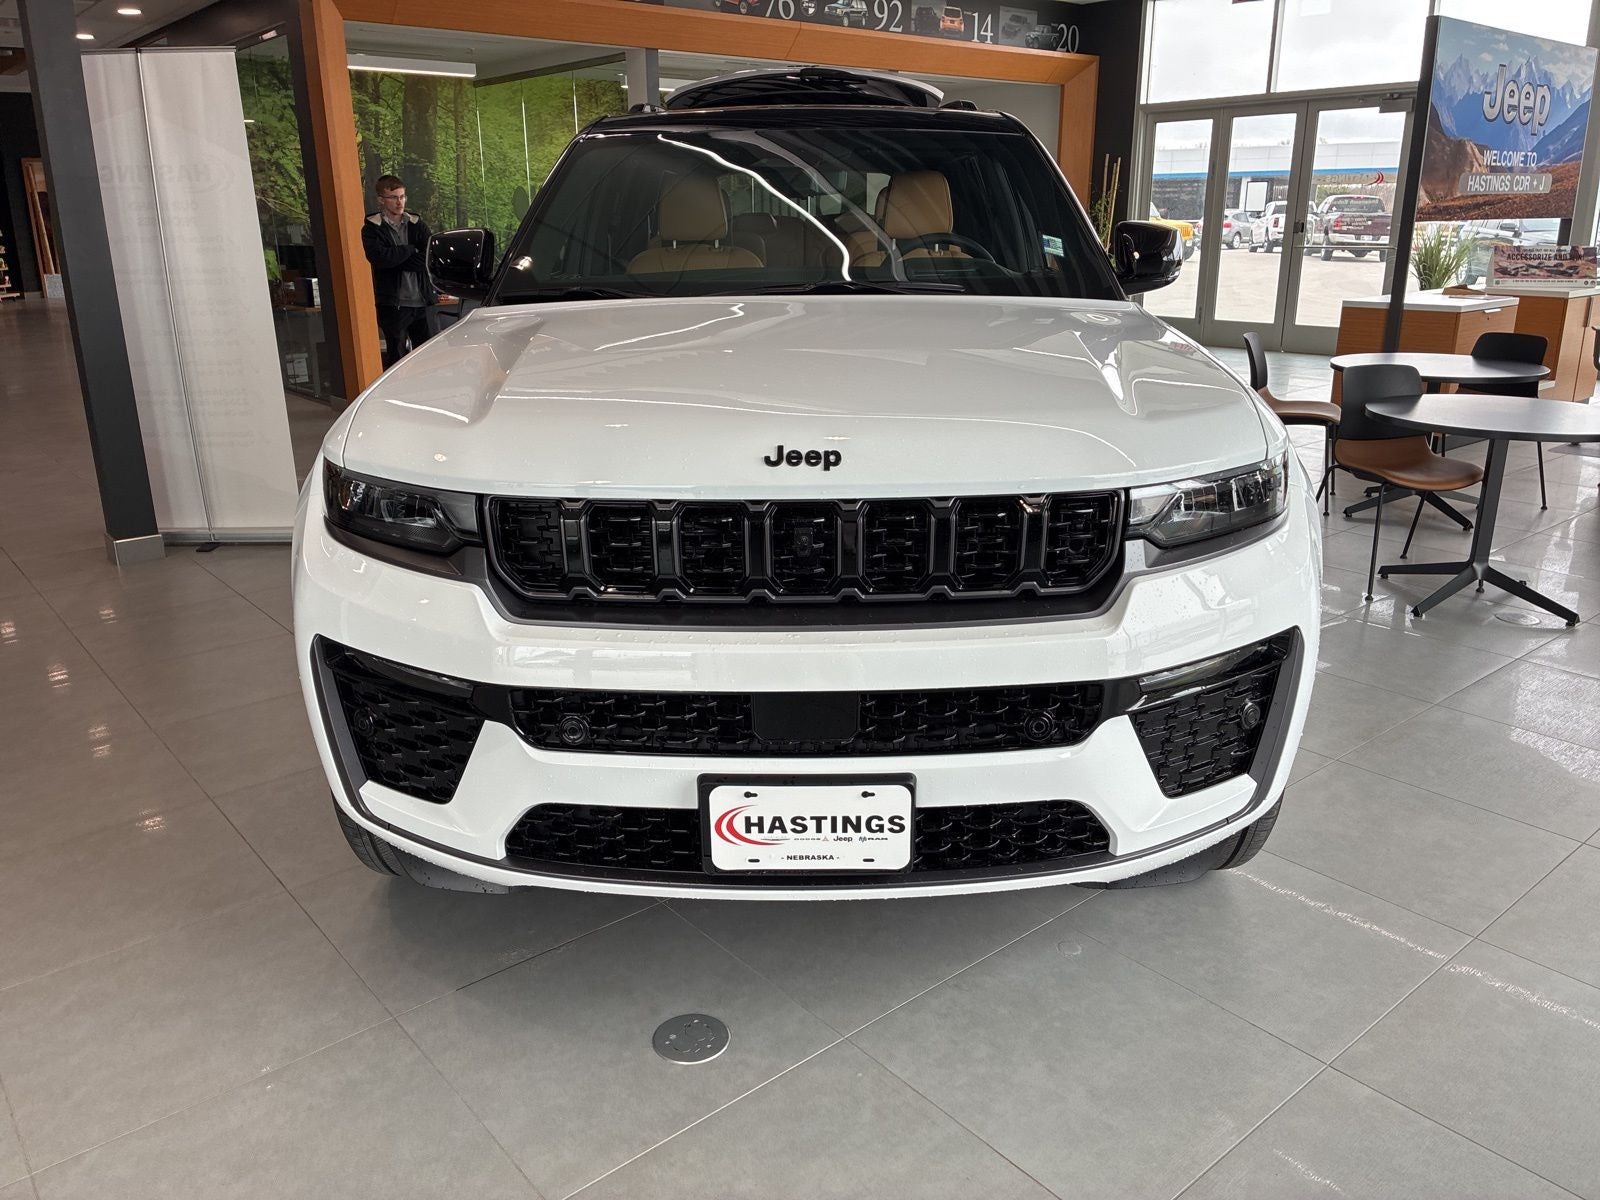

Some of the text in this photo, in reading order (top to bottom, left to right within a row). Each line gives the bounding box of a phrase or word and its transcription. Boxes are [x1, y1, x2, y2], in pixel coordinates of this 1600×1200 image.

[873, 0, 903, 32] 92
[971, 12, 994, 44] 14
[1057, 23, 1080, 54] 20
[1482, 63, 1551, 136] Jeep
[1483, 150, 1538, 168] WELCOME TO
[1467, 174, 1511, 192] HASTINGS
[1513, 175, 1531, 192] CDR
[1539, 176, 1546, 192] J
[763, 444, 842, 472] Jeep
[744, 815, 906, 834] HASTINGS
[833, 835, 853, 843] Jeep
